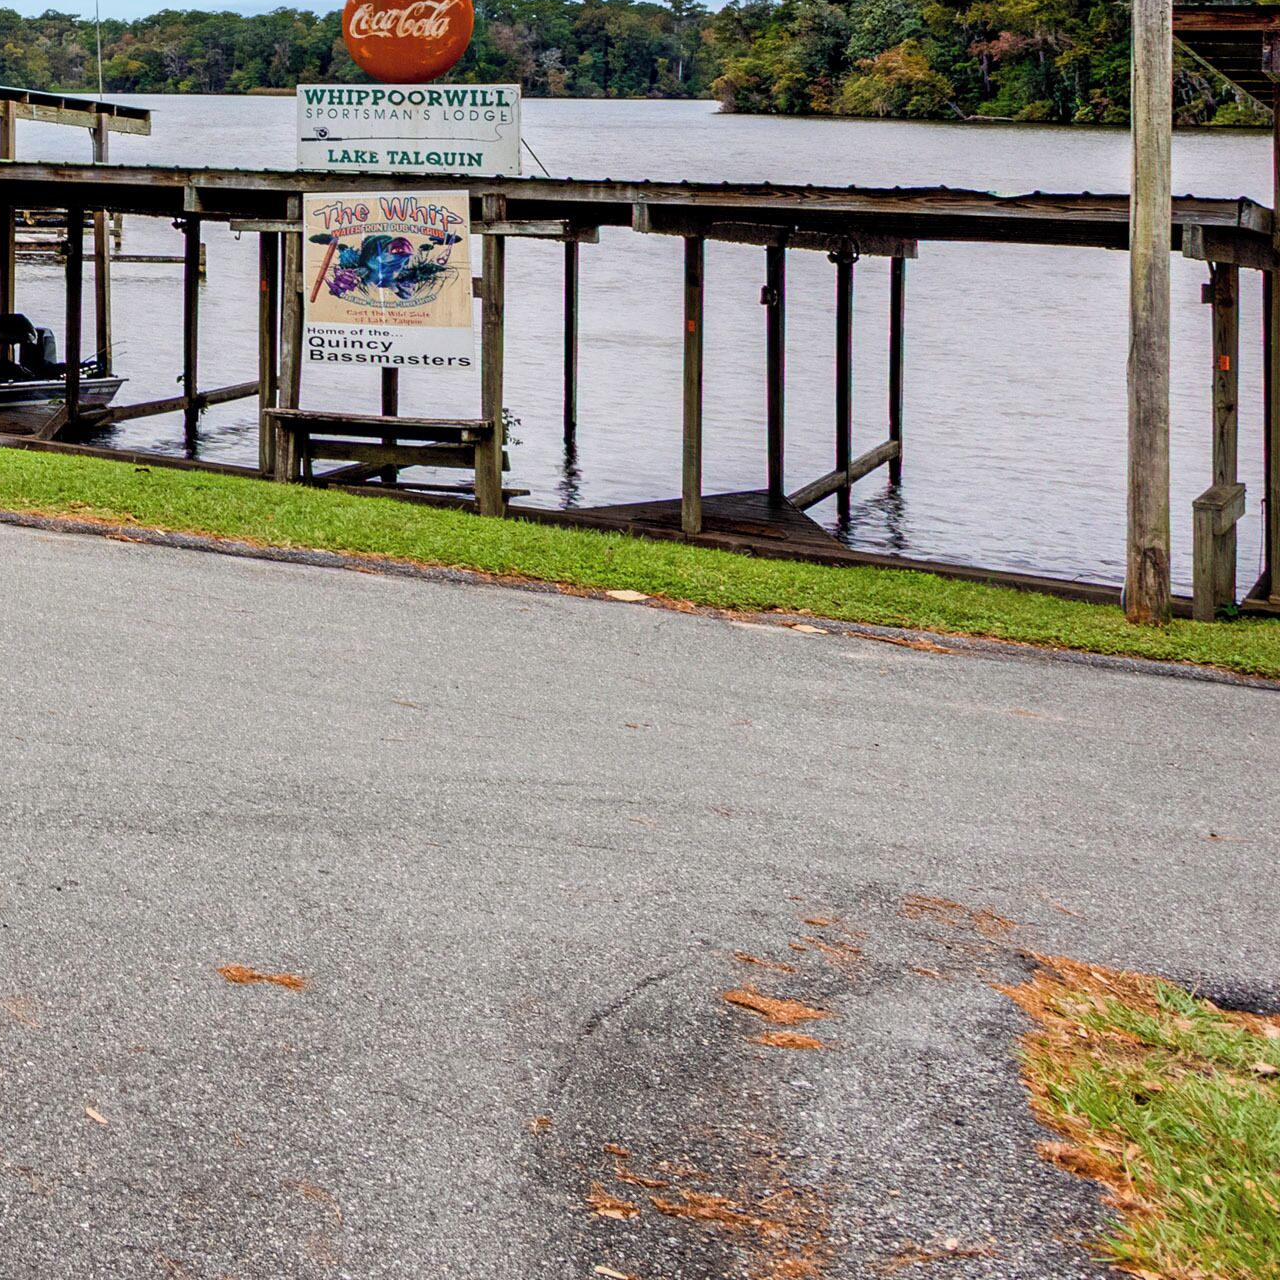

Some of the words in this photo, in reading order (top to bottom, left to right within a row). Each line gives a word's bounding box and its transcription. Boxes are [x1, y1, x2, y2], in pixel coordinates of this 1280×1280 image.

[304, 89, 510, 107] WHIPPOORWILL
[306, 108, 430, 120] SPORTSMAN'S
[443, 109, 508, 121] LODGE
[328, 149, 379, 164] LAKE
[387, 151, 483, 167] TALQUIN
[313, 200, 370, 229] The
[379, 197, 464, 231] Whip
[331, 223, 389, 238] WATERFRONT
[391, 223, 409, 233] PUB
[420, 226, 445, 239] GRUB
[307, 327, 345, 336] Home
[350, 328, 364, 336] of
[308, 336, 393, 352] Quincy
[309, 349, 471, 367] Bassmasters
